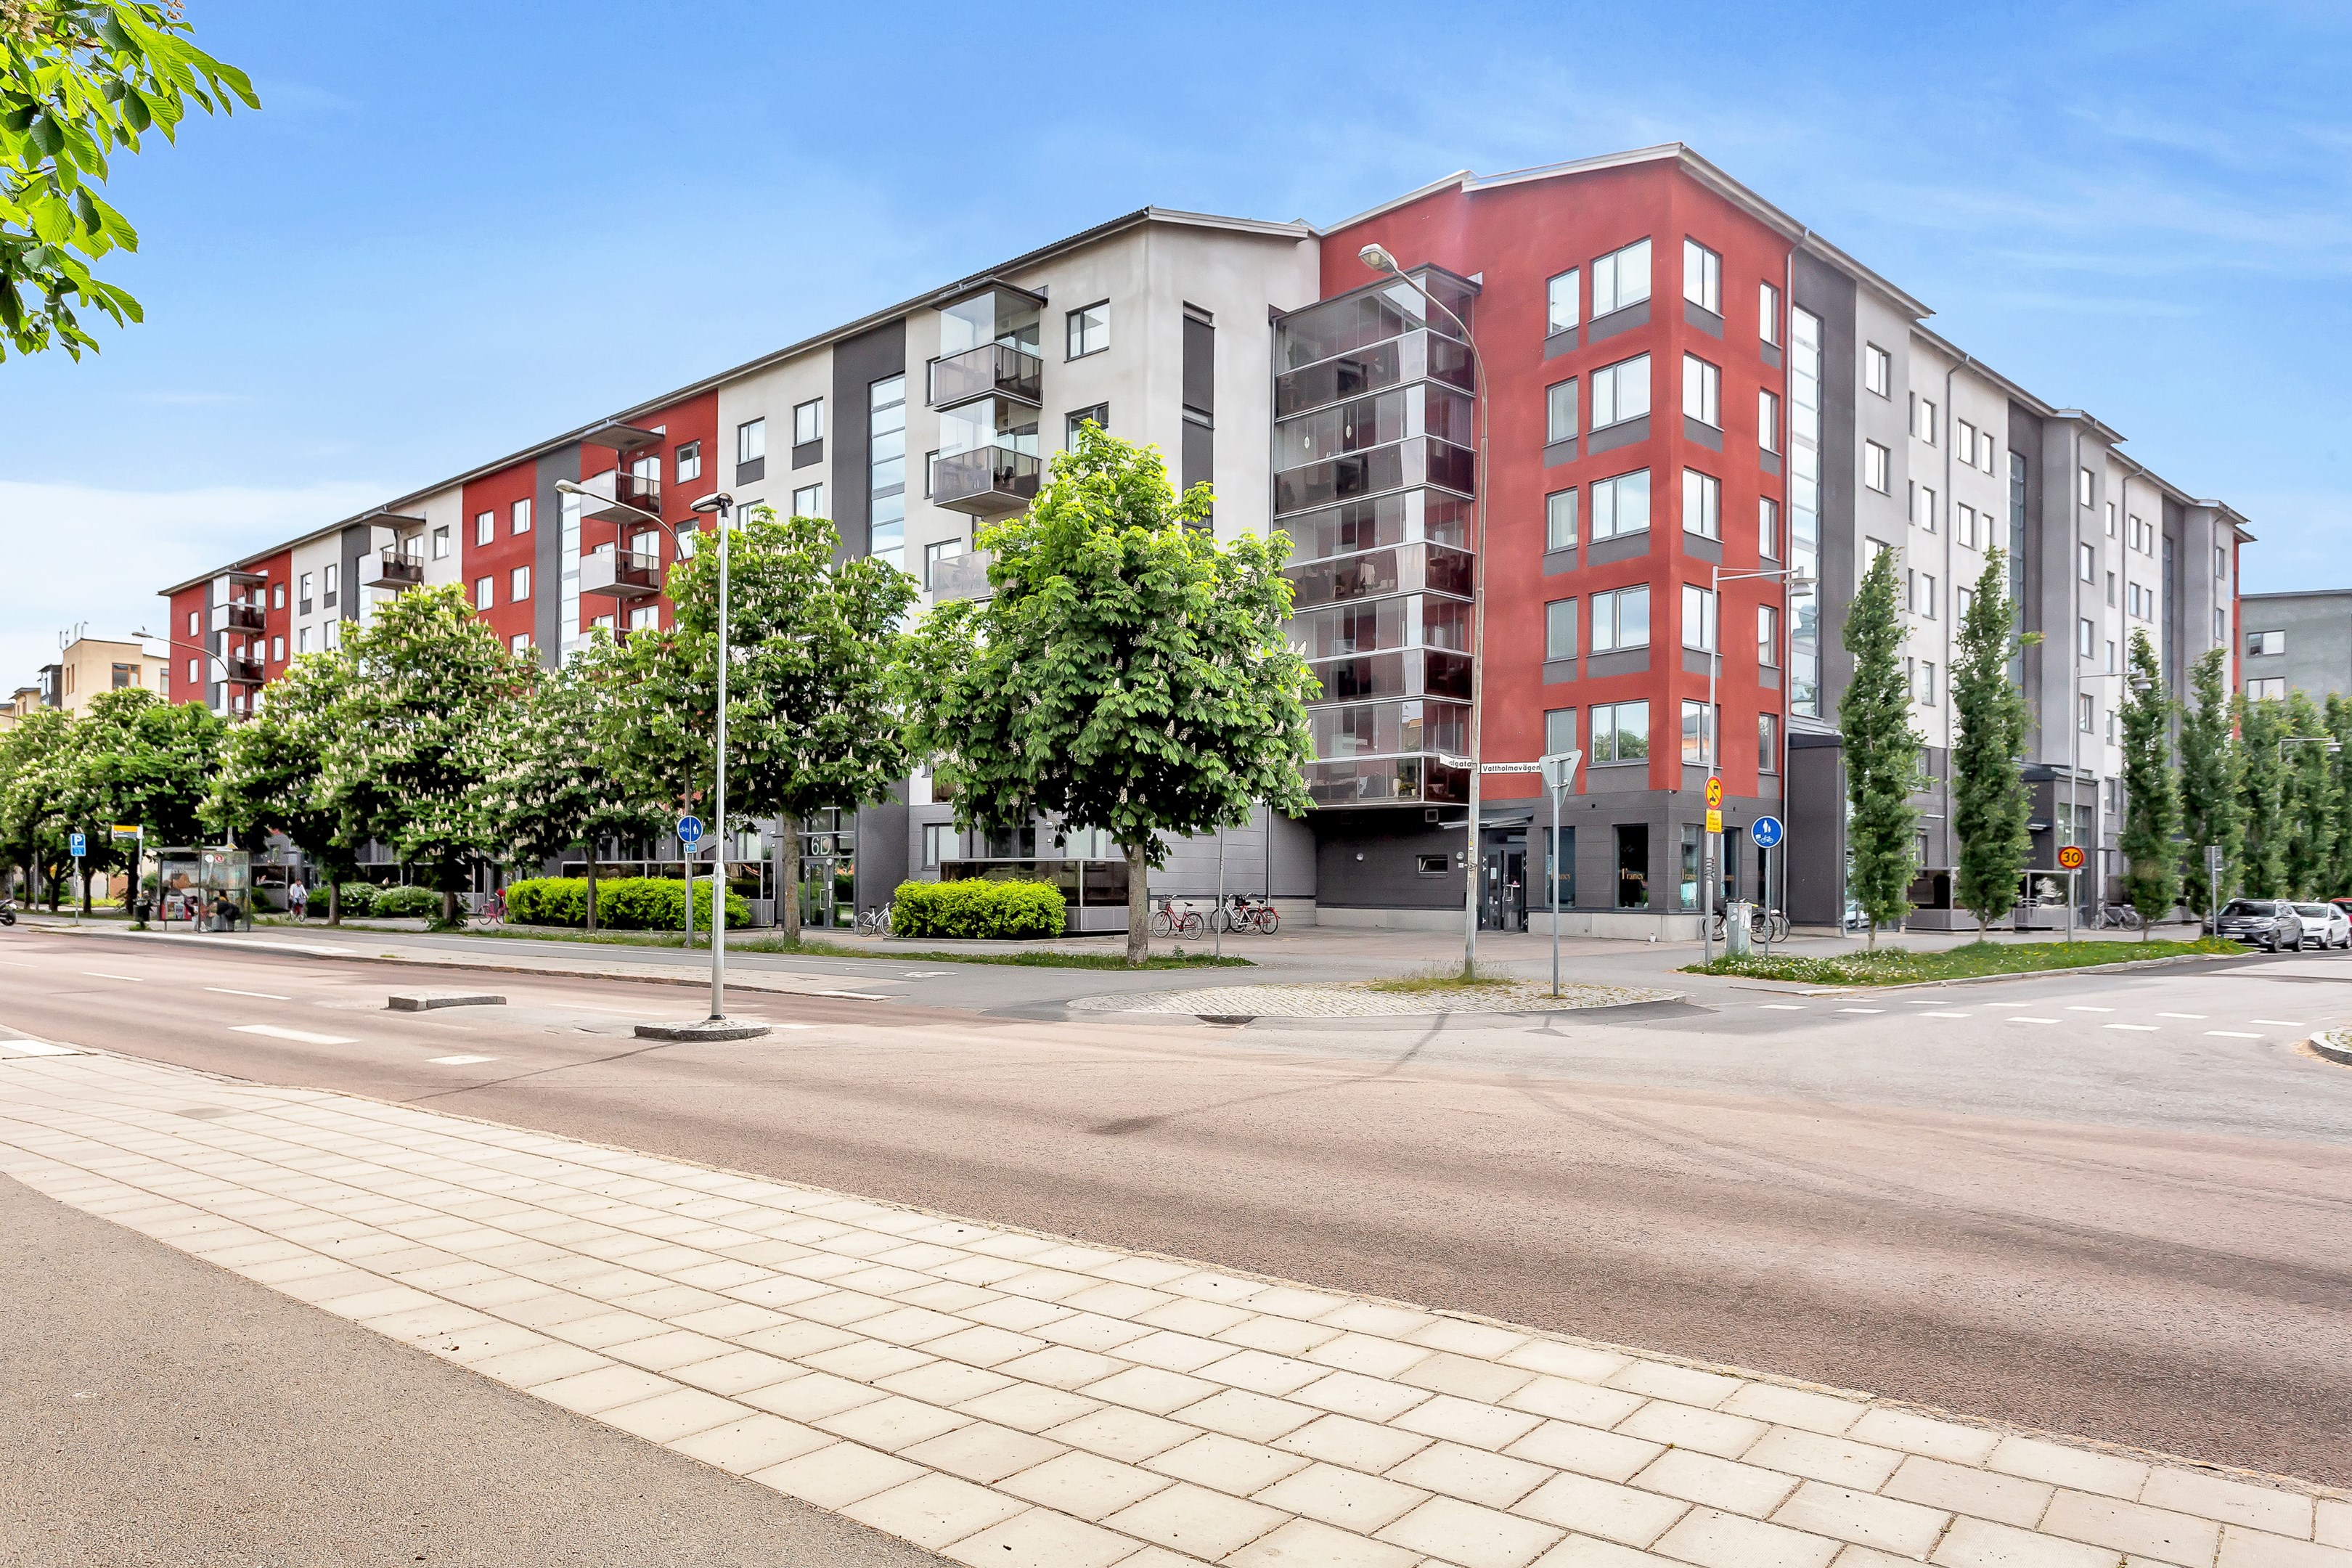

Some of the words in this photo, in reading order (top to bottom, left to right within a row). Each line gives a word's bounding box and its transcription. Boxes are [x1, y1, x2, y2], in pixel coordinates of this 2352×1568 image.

[73, 835, 83, 846] P
[811, 836, 830, 855] 6D
[2062, 852, 2080, 862] 30
